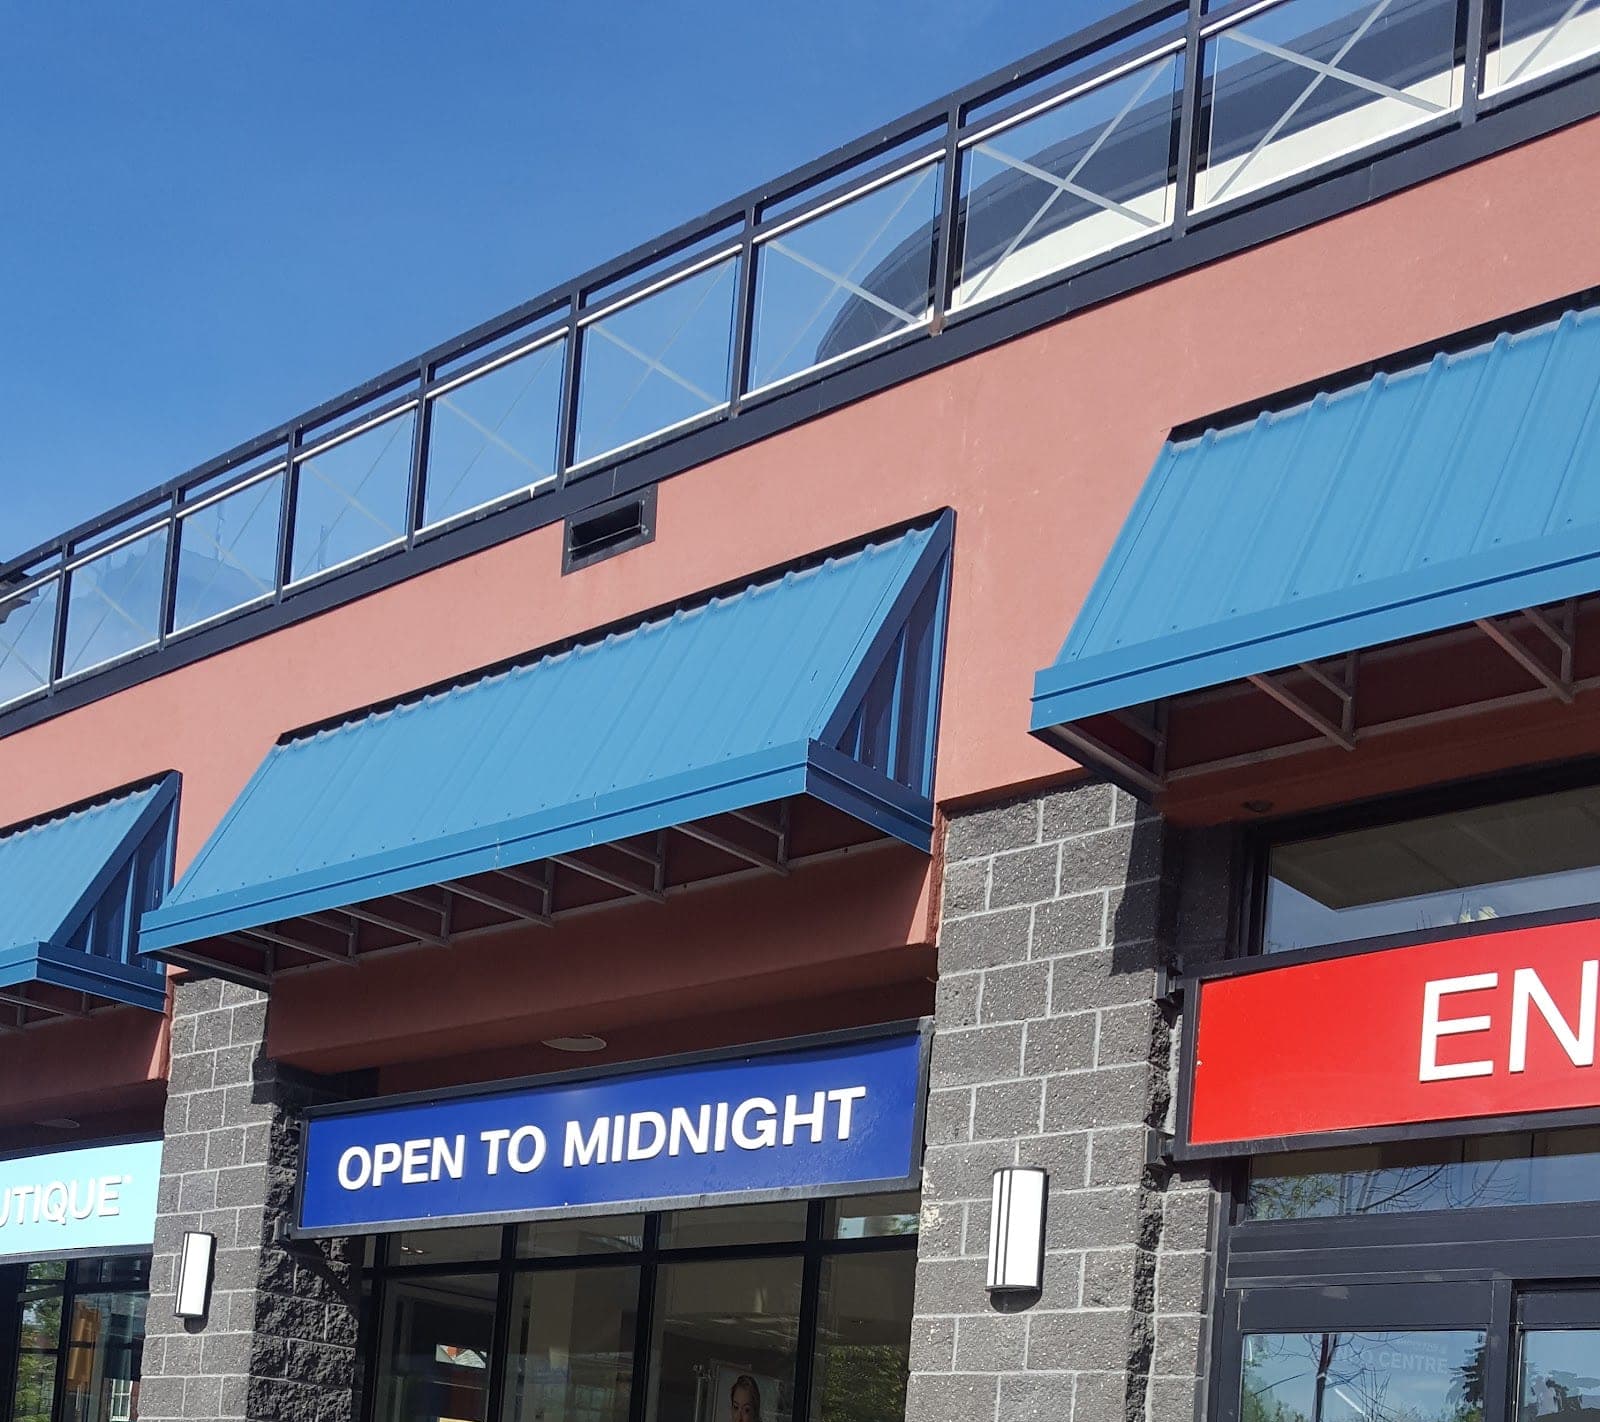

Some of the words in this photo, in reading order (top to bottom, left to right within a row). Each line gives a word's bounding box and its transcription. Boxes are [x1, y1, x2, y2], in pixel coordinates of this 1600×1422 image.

[1419, 959, 1600, 1082] EN
[337, 1133, 466, 1191] OPEN
[480, 1125, 546, 1175] TO
[563, 1086, 867, 1168] MIDNIGHT
